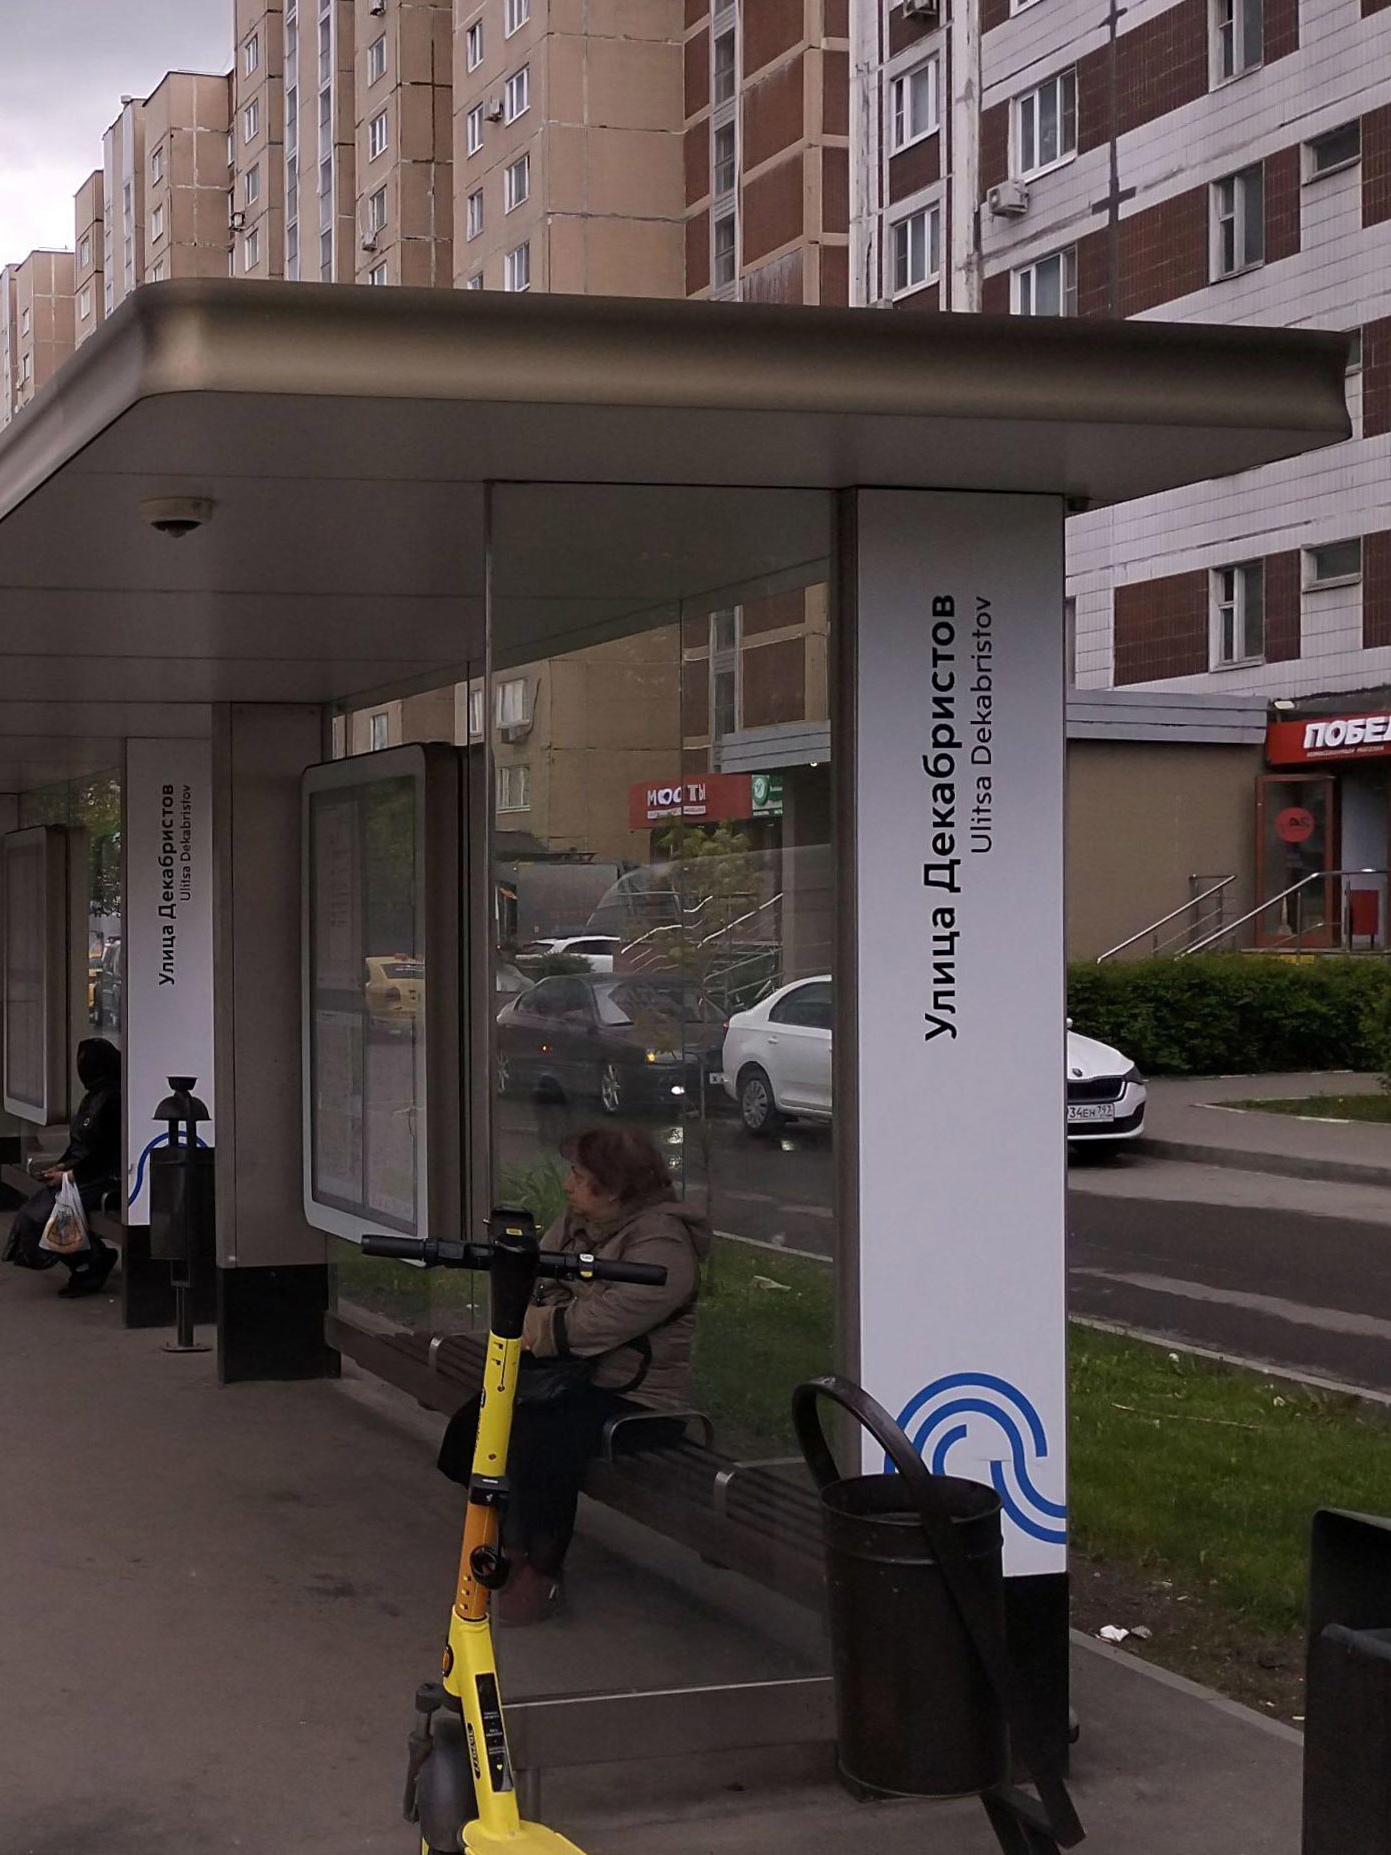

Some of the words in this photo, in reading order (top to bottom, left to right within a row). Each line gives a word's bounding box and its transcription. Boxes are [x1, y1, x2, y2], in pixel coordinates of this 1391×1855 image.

[970, 596, 993, 765] Dekabristov
[922, 594, 962, 893] Декабристов
[1303, 715, 1391, 749] ПОБЕ
[158, 784, 177, 919] Декабристов
[180, 785, 192, 862] Dekabristov
[970, 775, 993, 853] Ulitsa
[180, 866, 192, 901] Ulitsa
[158, 925, 176, 985] Улица
[924, 905, 960, 1041] Улица
[1067, 1106, 1096, 1118] 34ЕН
